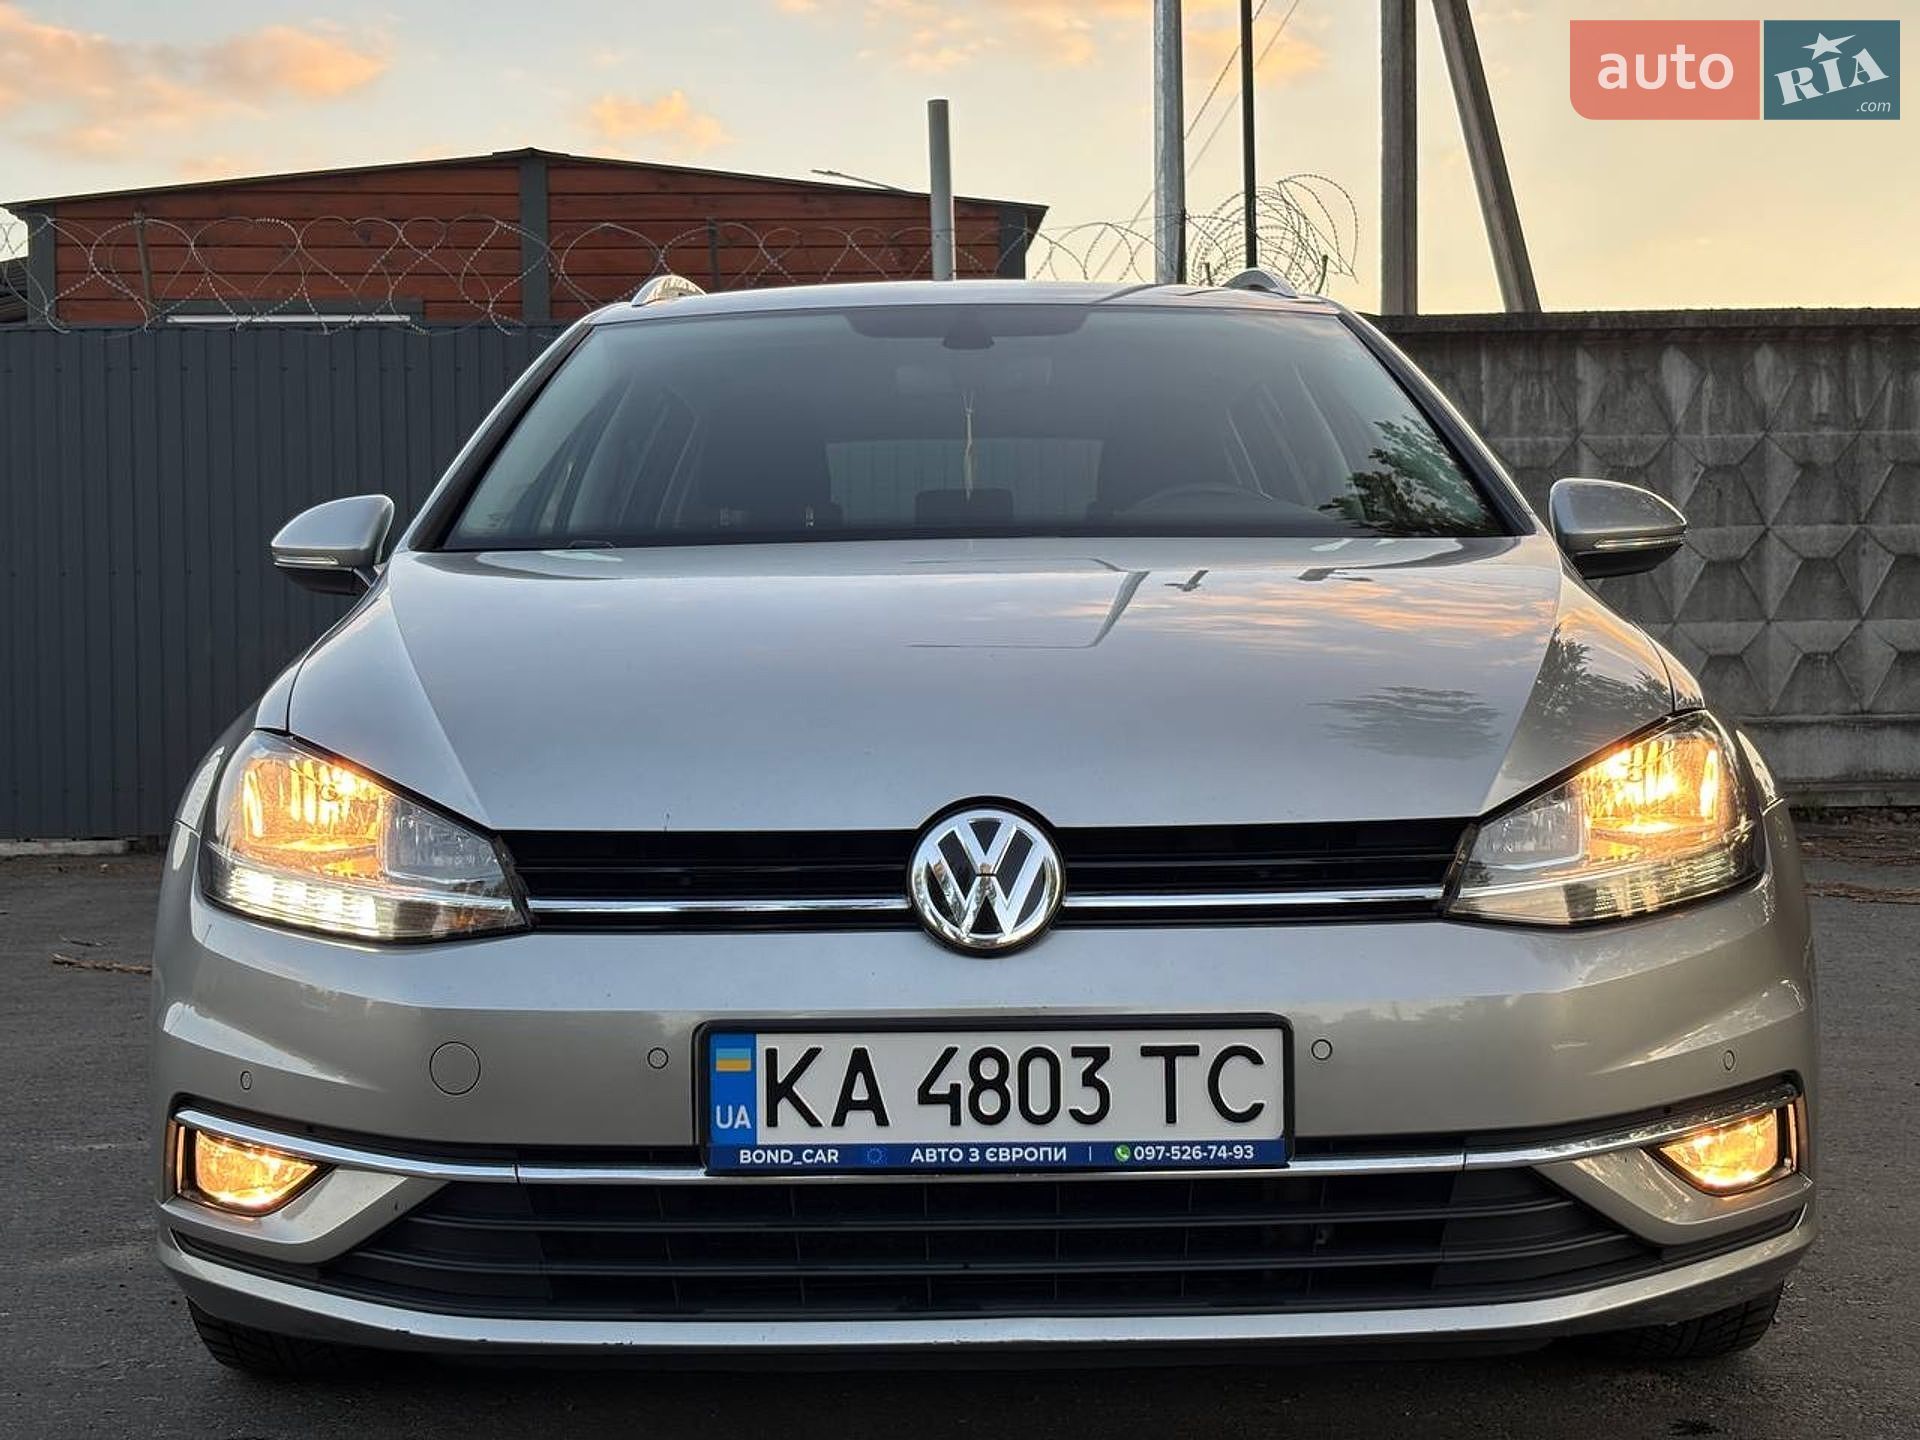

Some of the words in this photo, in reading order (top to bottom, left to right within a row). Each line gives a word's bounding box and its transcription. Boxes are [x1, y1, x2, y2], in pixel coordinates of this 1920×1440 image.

[764, 1046, 890, 1128] KA
[917, 1045, 1111, 1126] 4803
[1140, 1044, 1265, 1124] TC
[715, 1104, 752, 1130] UA
[738, 1148, 840, 1166] BOND_CAR
[910, 1147, 964, 1163] АВТО
[984, 1146, 1068, 1162] ЄВРОПИ
[1133, 1144, 1255, 1161] 097-526-74-93
